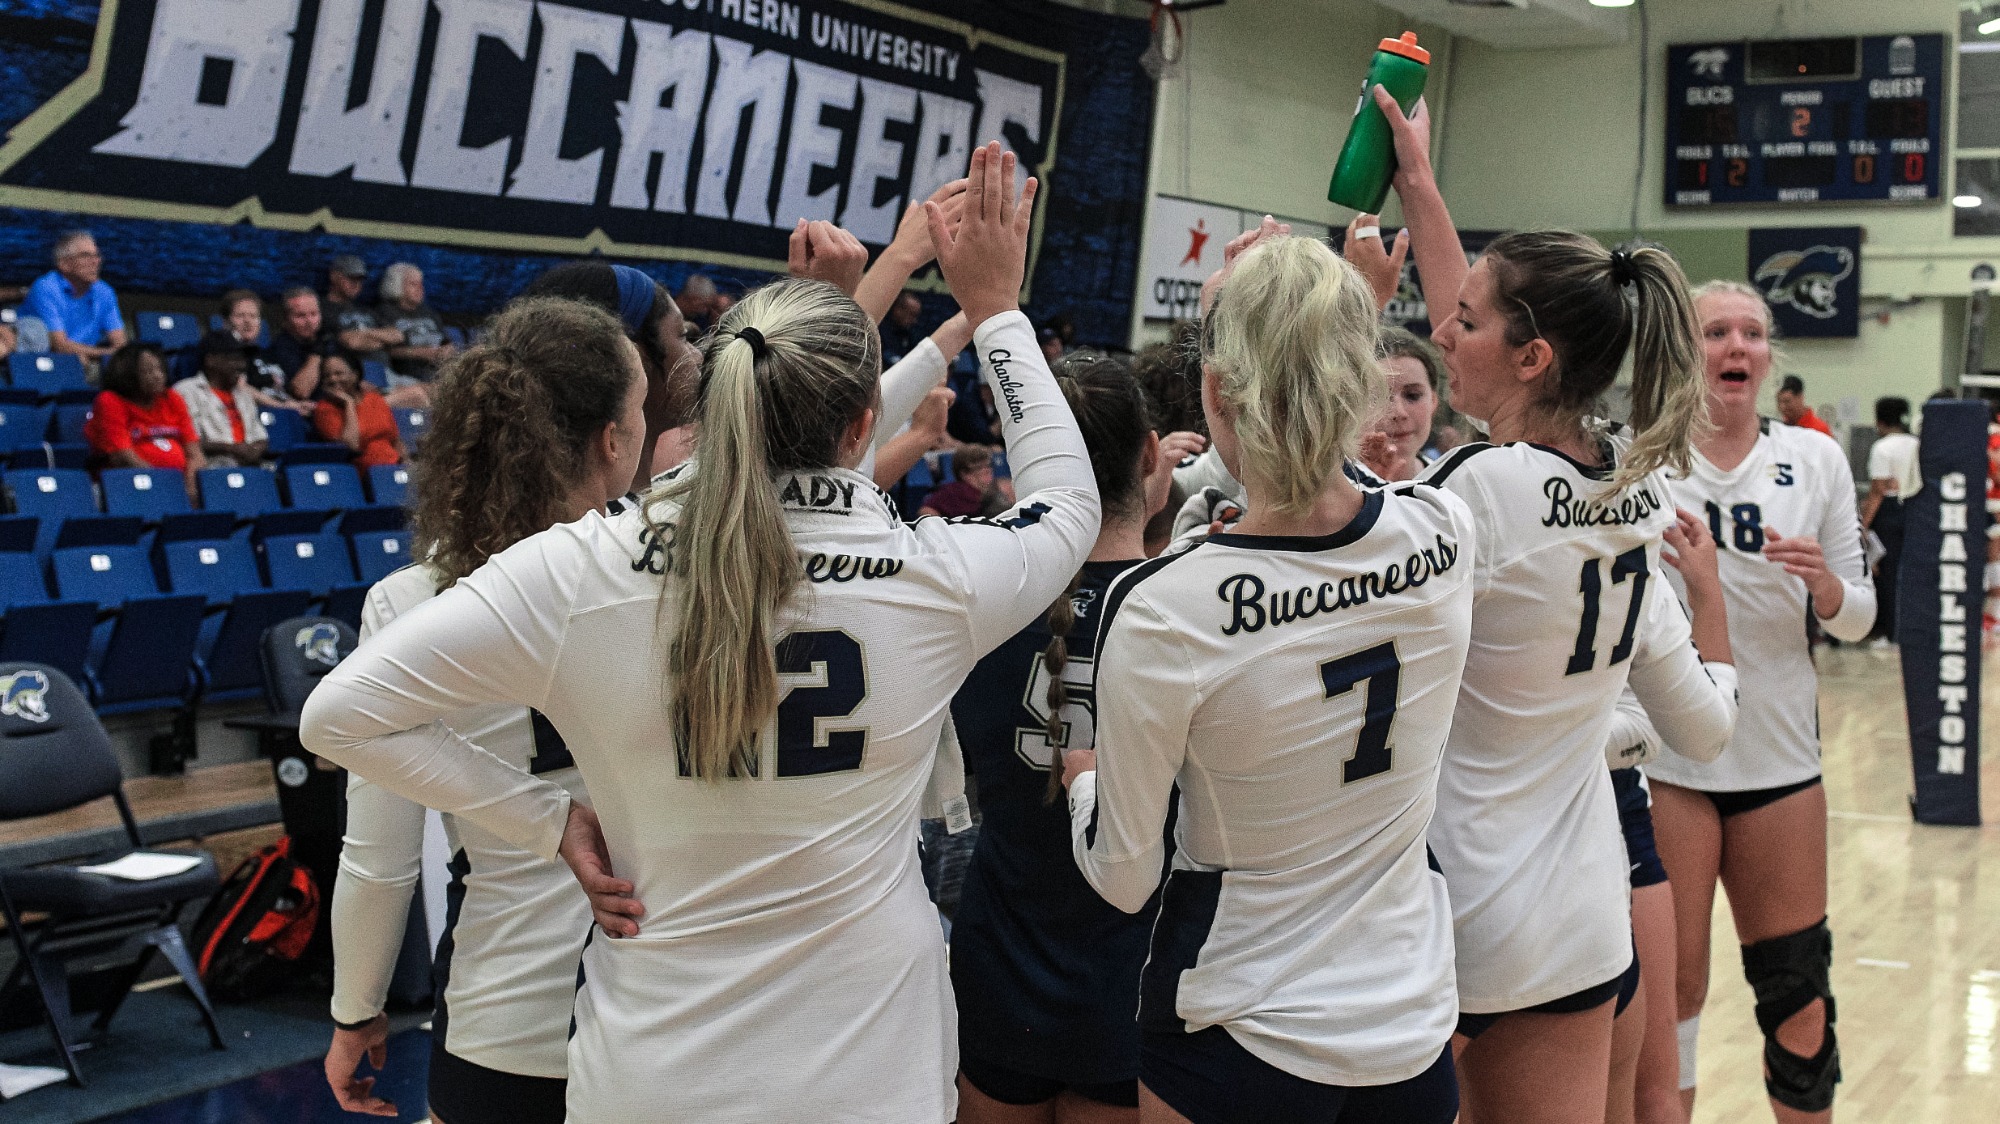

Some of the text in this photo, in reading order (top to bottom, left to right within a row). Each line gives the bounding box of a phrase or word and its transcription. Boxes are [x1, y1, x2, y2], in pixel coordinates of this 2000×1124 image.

[811, 12, 960, 81] UNIVERSITY
[1869, 77, 1925, 99] GUEST
[1791, 107, 1811, 137] 2
[1698, 160, 1707, 185] 1
[1728, 159, 1746, 187] 2
[1854, 155, 1873, 183] 0
[1905, 153, 1924, 182] 0
[988, 348, 1024, 424] Charleston
[779, 475, 854, 508] ADY
[1704, 500, 1764, 554] 18
[1217, 533, 1458, 637] Buccaneers
[1564, 543, 1651, 677] 17
[1939, 472, 1968, 775] CHARLESTON
[1014, 651, 1097, 772] 5
[1317, 638, 1403, 787] 7
